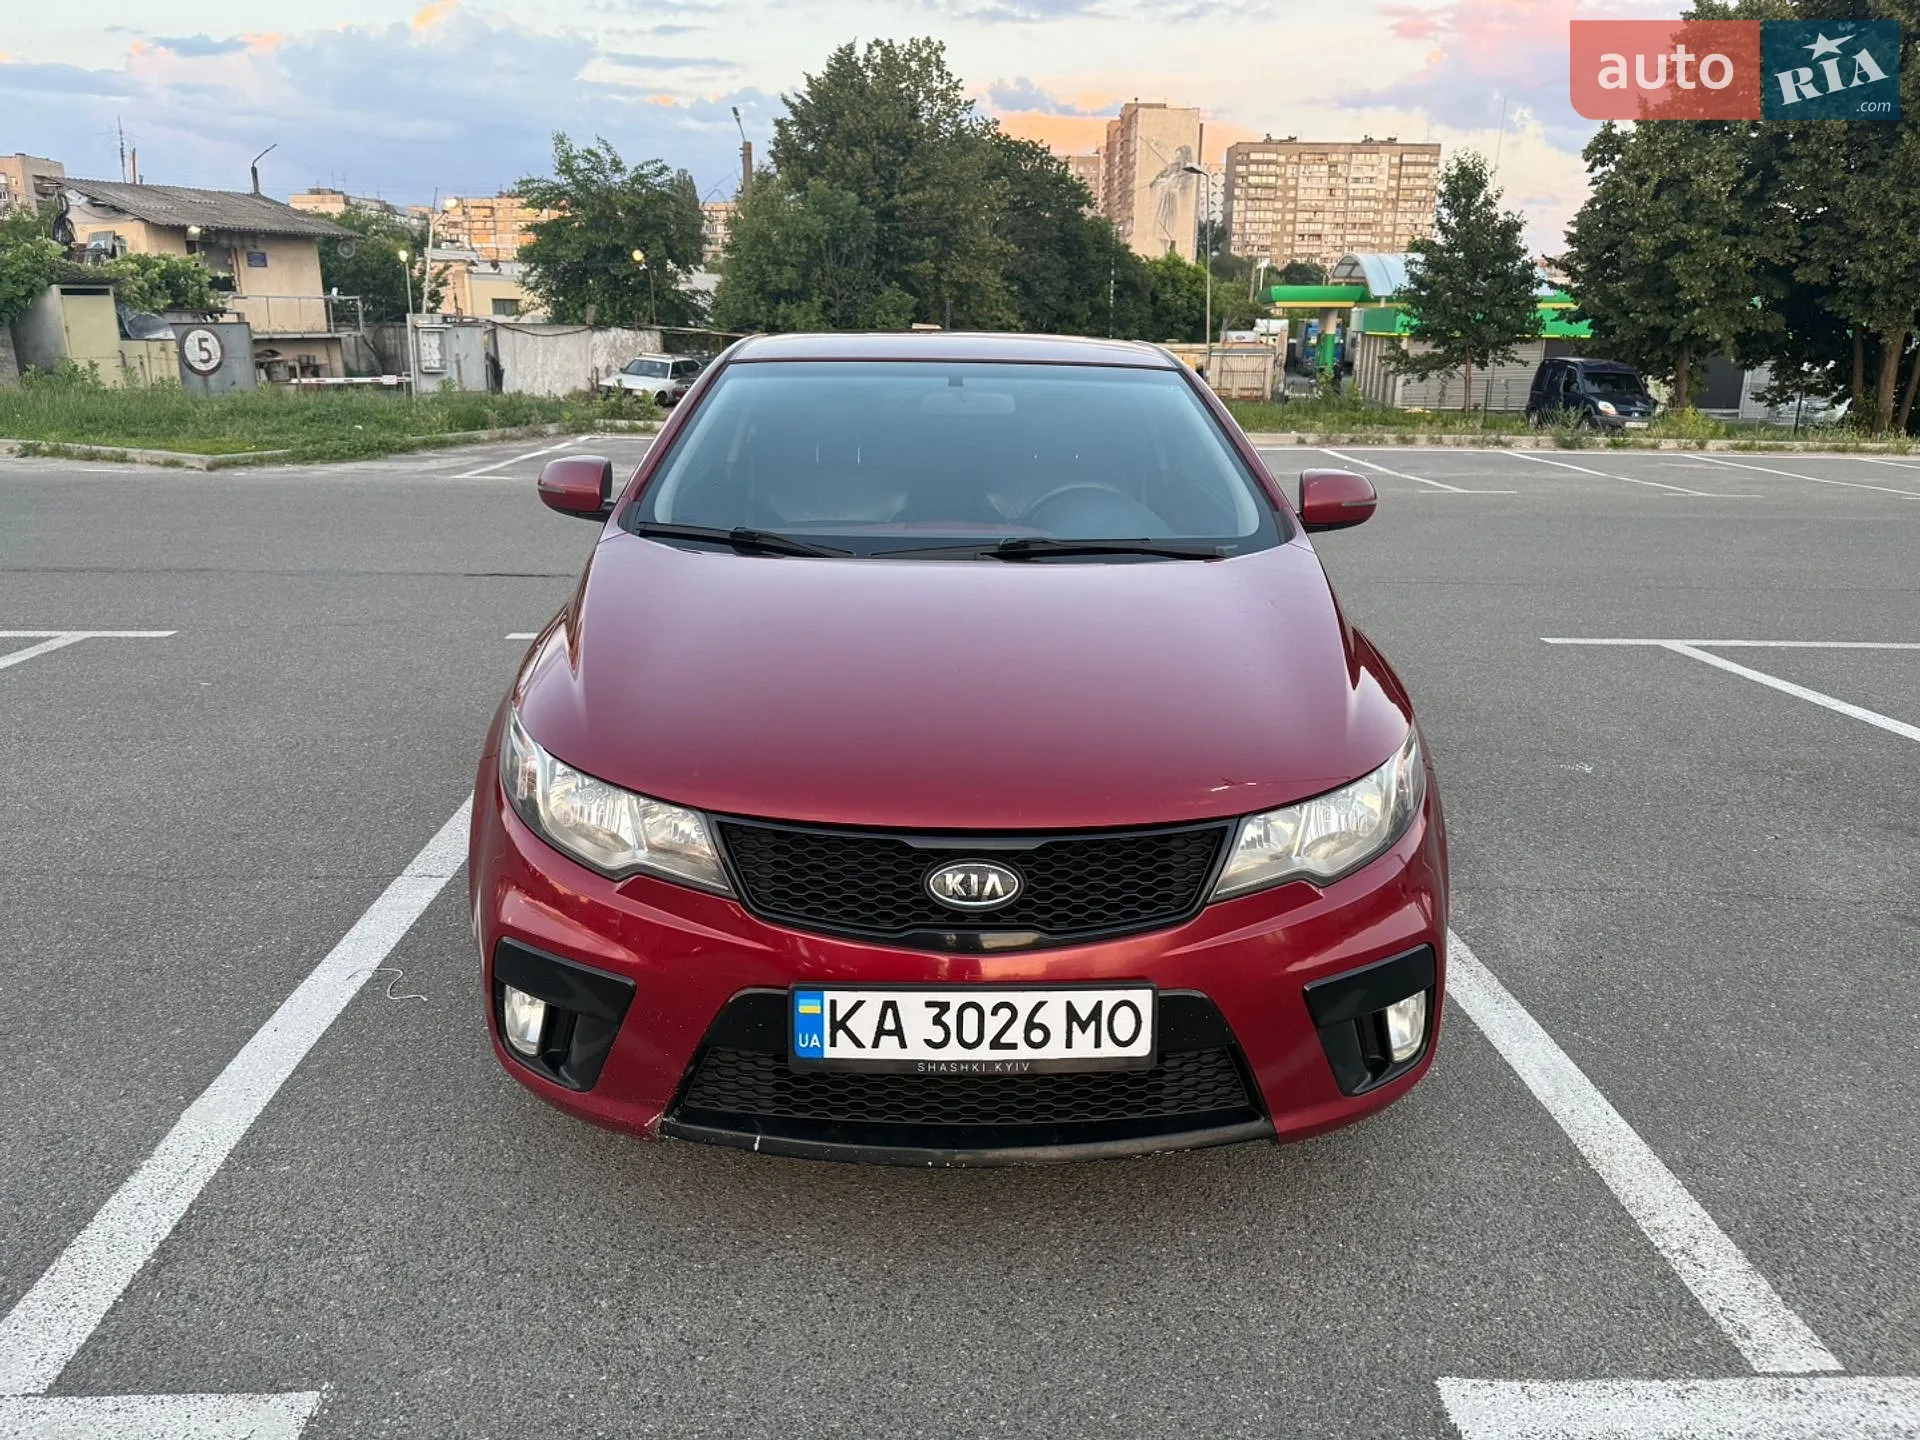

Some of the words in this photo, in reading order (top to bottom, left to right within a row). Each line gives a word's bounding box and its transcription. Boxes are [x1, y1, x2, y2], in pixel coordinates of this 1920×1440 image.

[197, 337, 212, 364] 5
[943, 873, 1004, 896] KIA
[828, 999, 908, 1049] KA
[922, 1000, 1052, 1051] 3026
[1065, 999, 1143, 1050] MO
[798, 1032, 822, 1048] UA
